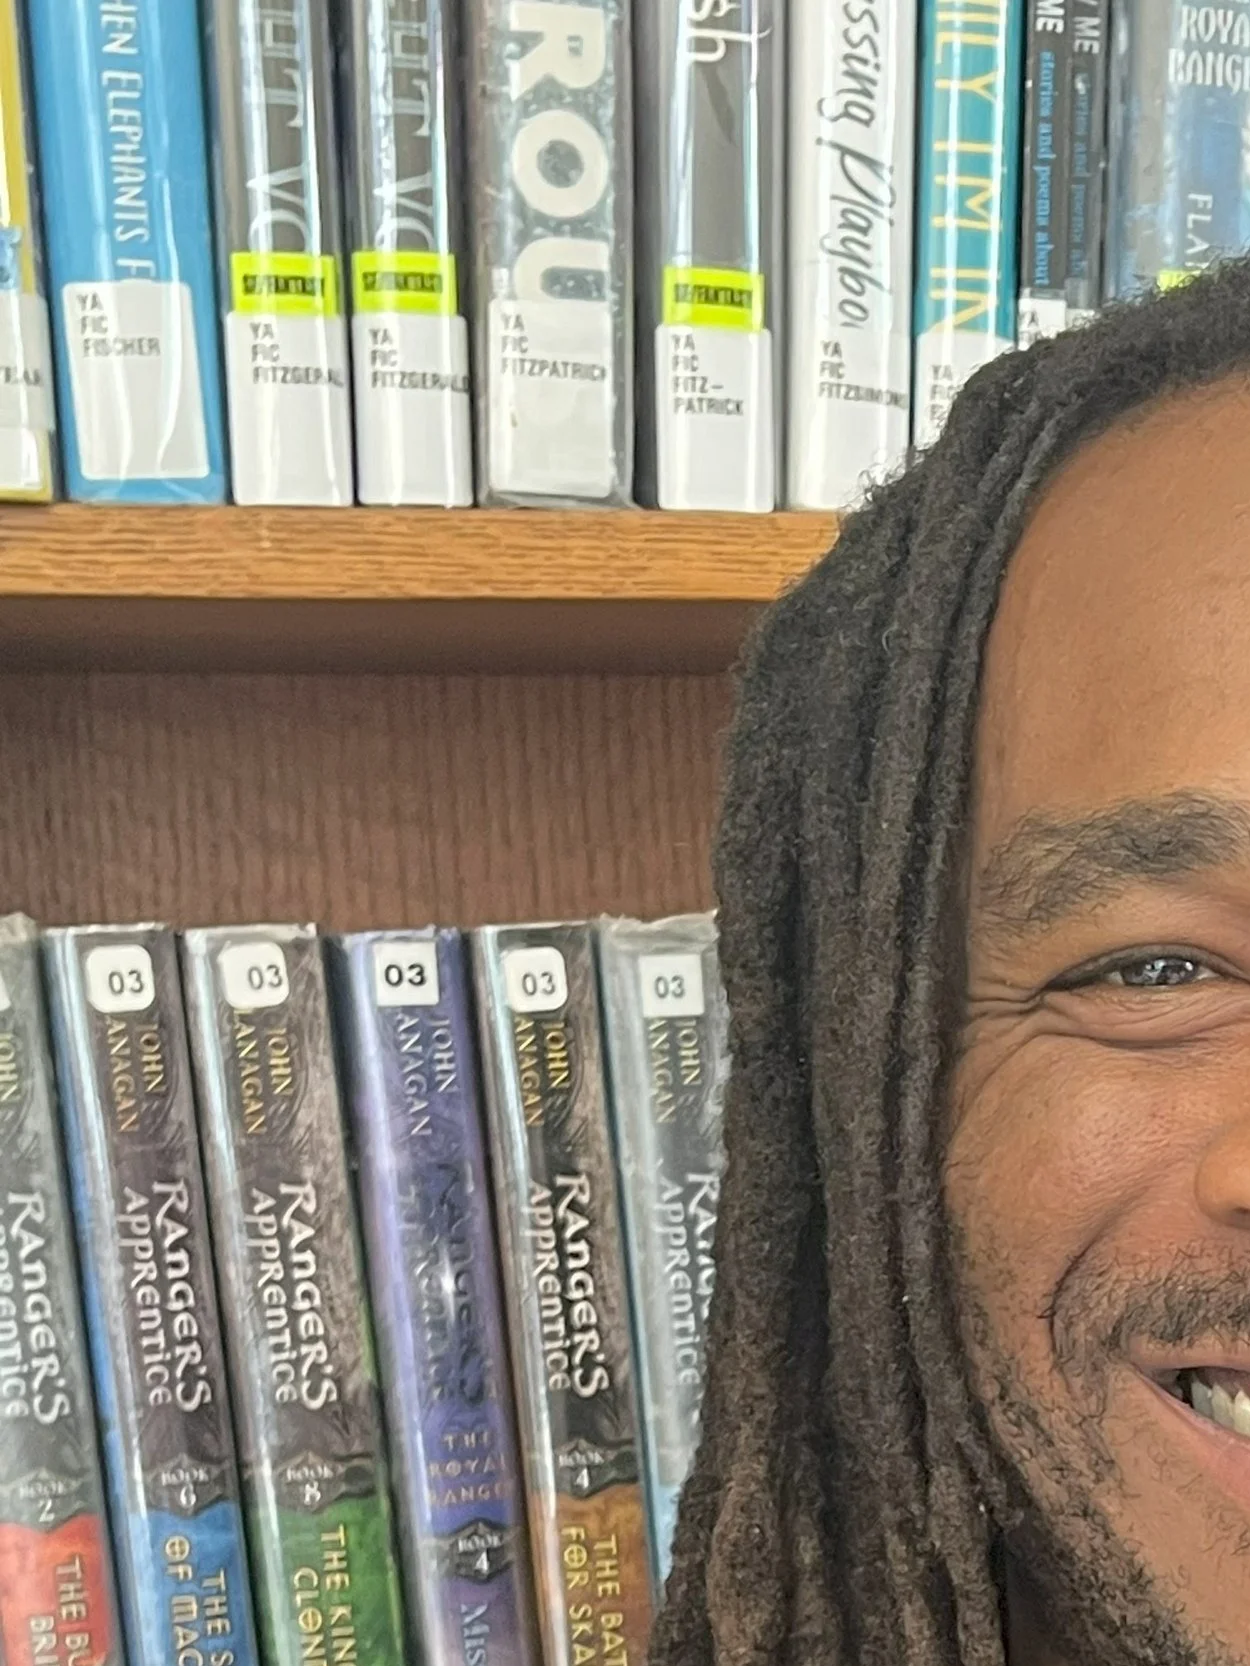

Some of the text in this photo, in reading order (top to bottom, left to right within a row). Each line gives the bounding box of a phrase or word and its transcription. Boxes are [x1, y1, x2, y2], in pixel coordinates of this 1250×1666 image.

[932, 0, 1003, 103] ILY
[1073, 16, 1101, 54] ME
[102, 69, 150, 244] ELEPHANTS
[1037, 123, 1056, 159] and
[1032, 165, 1051, 226] poems
[1034, 232, 1054, 284] about
[250, 322, 274, 340] YA
[369, 328, 393, 345] YA
[501, 314, 525, 331] YA
[251, 344, 280, 363] FIC
[371, 350, 398, 367] FIC
[501, 336, 529, 353] FIC
[672, 334, 696, 350] YA
[821, 340, 843, 358] YA
[673, 355, 699, 372] FIC
[673, 398, 744, 415] PATRICK
[107, 969, 145, 995] 03
[248, 965, 283, 991] 03
[384, 963, 427, 987] 03
[521, 971, 556, 996] 03
[654, 975, 686, 998] 03
[134, 1022, 166, 1094] JOHN
[267, 1027, 294, 1098] JOHN
[429, 1018, 459, 1094] JOHN
[514, 1016, 544, 1128] ANAGAN
[544, 1020, 570, 1091] JOHN
[649, 1018, 676, 1124] ANAGAN
[105, 1016, 139, 1134] ANAGAN
[395, 1012, 431, 1137] ANAGAN
[179, 1484, 197, 1508] 6
[574, 1467, 590, 1490] 4
[37, 1499, 56, 1522] 2
[165, 1535, 194, 1582] OF
[321, 1523, 350, 1591] THE
[474, 1550, 490, 1573] 4
[561, 1525, 590, 1591] FOR
[593, 1533, 621, 1598] THE
[56, 1554, 87, 1622] THE
[202, 1568, 231, 1636] THE
